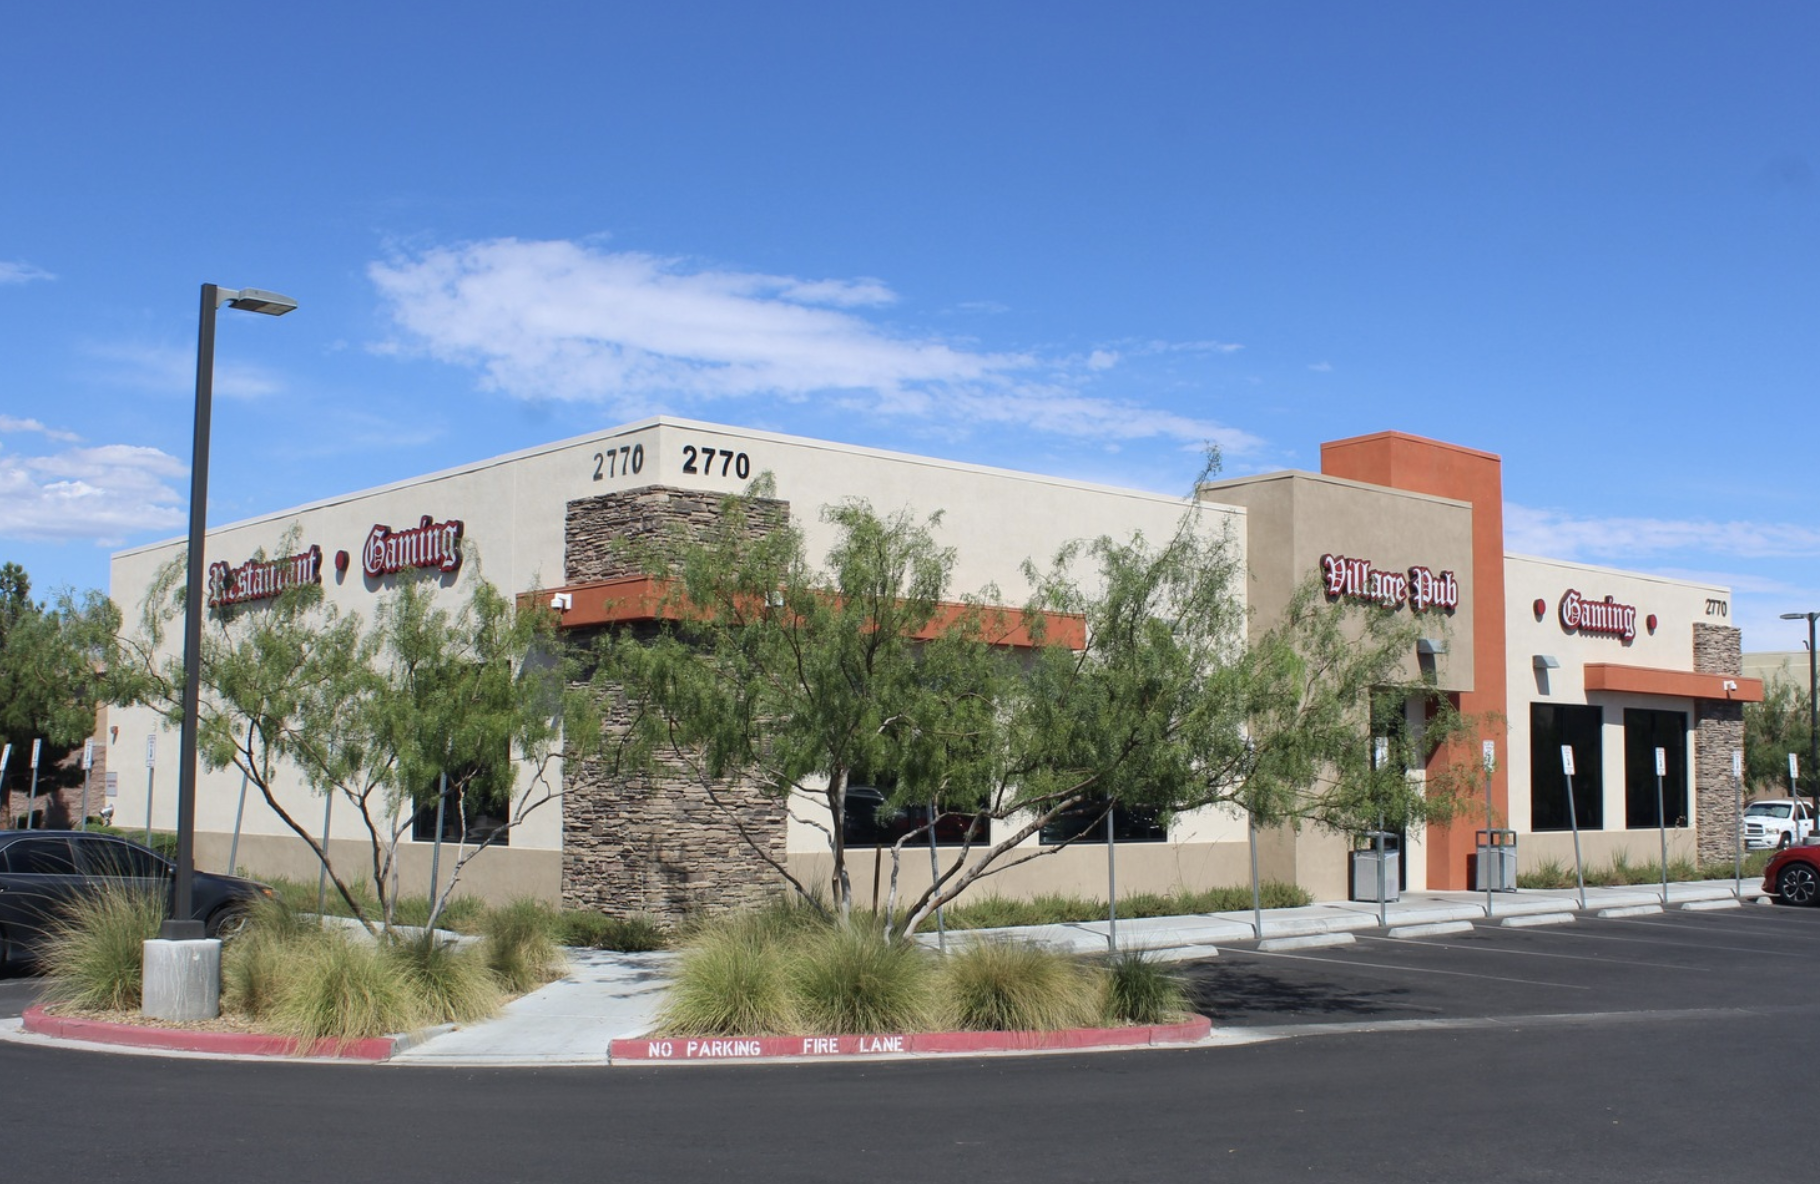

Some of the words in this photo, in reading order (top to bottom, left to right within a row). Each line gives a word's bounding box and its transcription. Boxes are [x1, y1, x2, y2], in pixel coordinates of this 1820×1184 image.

[593, 443, 644, 481] 2770
[683, 445, 750, 480] 2770
[363, 517, 460, 576] Gaming
[1323, 554, 1406, 607] Village
[1412, 567, 1457, 609] Pub
[1562, 591, 1635, 638] Gaming
[1705, 599, 1728, 617] 2770
[648, 1041, 673, 1058] NO
[687, 1040, 761, 1057] PARKING
[803, 1037, 839, 1054] FIRE
[860, 1036, 904, 1052] LANE
